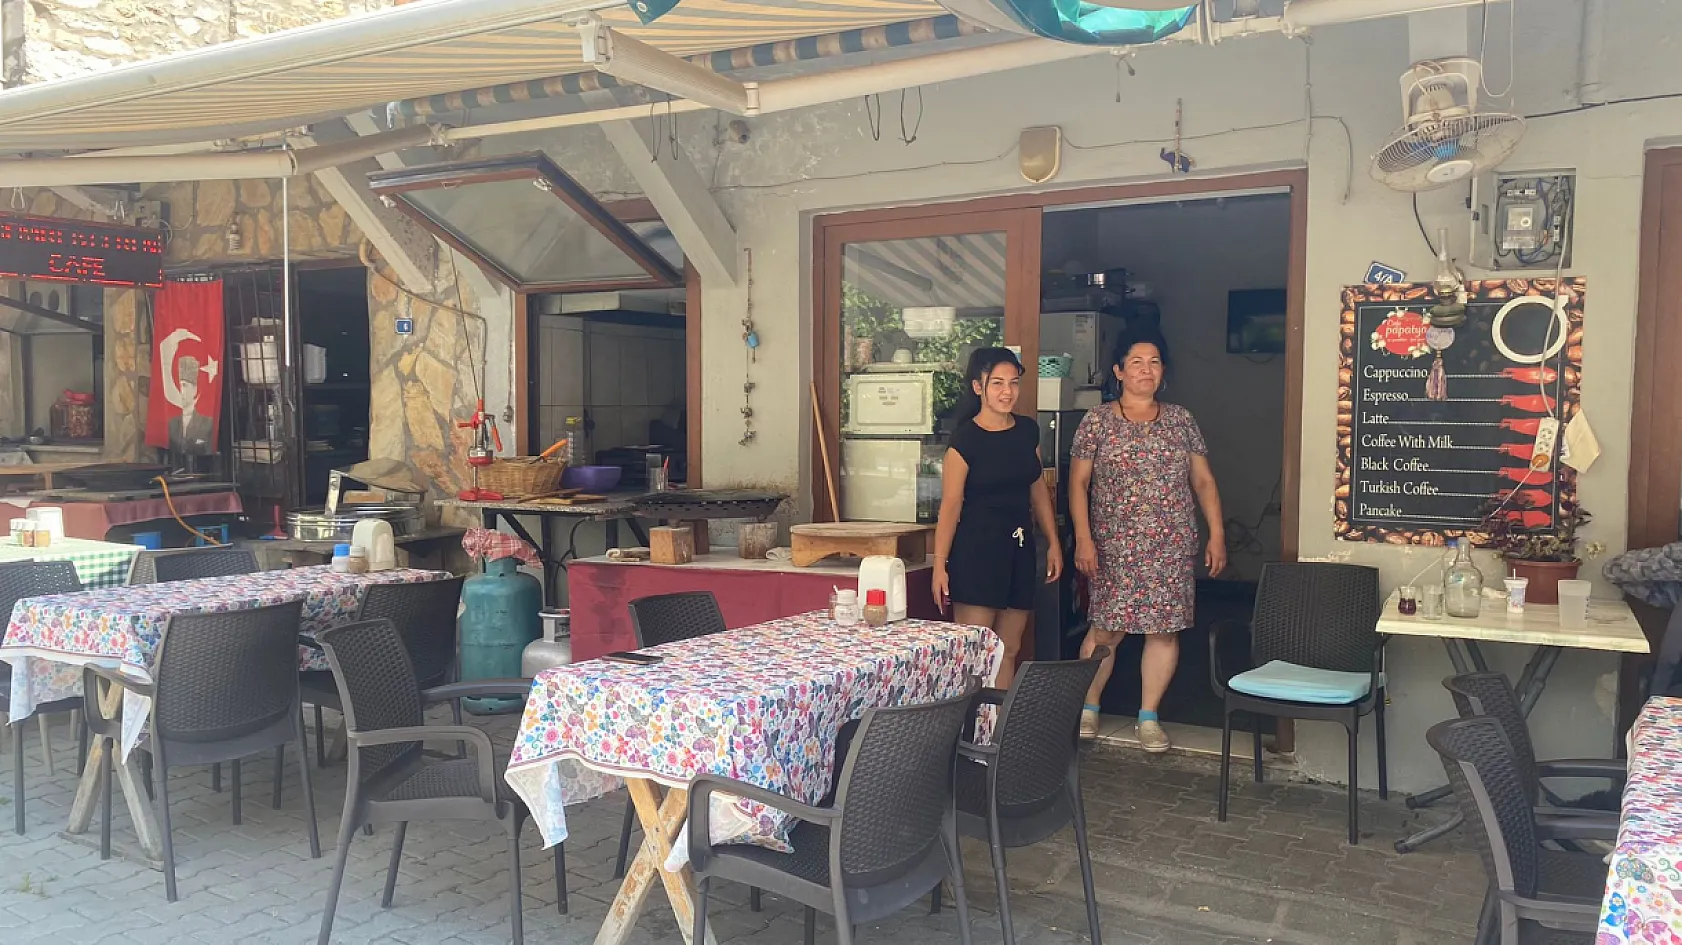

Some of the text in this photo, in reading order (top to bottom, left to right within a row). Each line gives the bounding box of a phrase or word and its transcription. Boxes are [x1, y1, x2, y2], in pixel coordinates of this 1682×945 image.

[49, 253, 105, 276] CAFE
[1363, 364, 1428, 383] Cappuccino
[1363, 387, 1409, 406] Espresso
[1362, 411, 1390, 424] Latte
[1361, 433, 1454, 449] Coffee With Milk
[1360, 456, 1430, 472] Black Coffee
[1359, 480, 1440, 496] Turkish Coffee
[1359, 502, 1403, 518] Pancake
